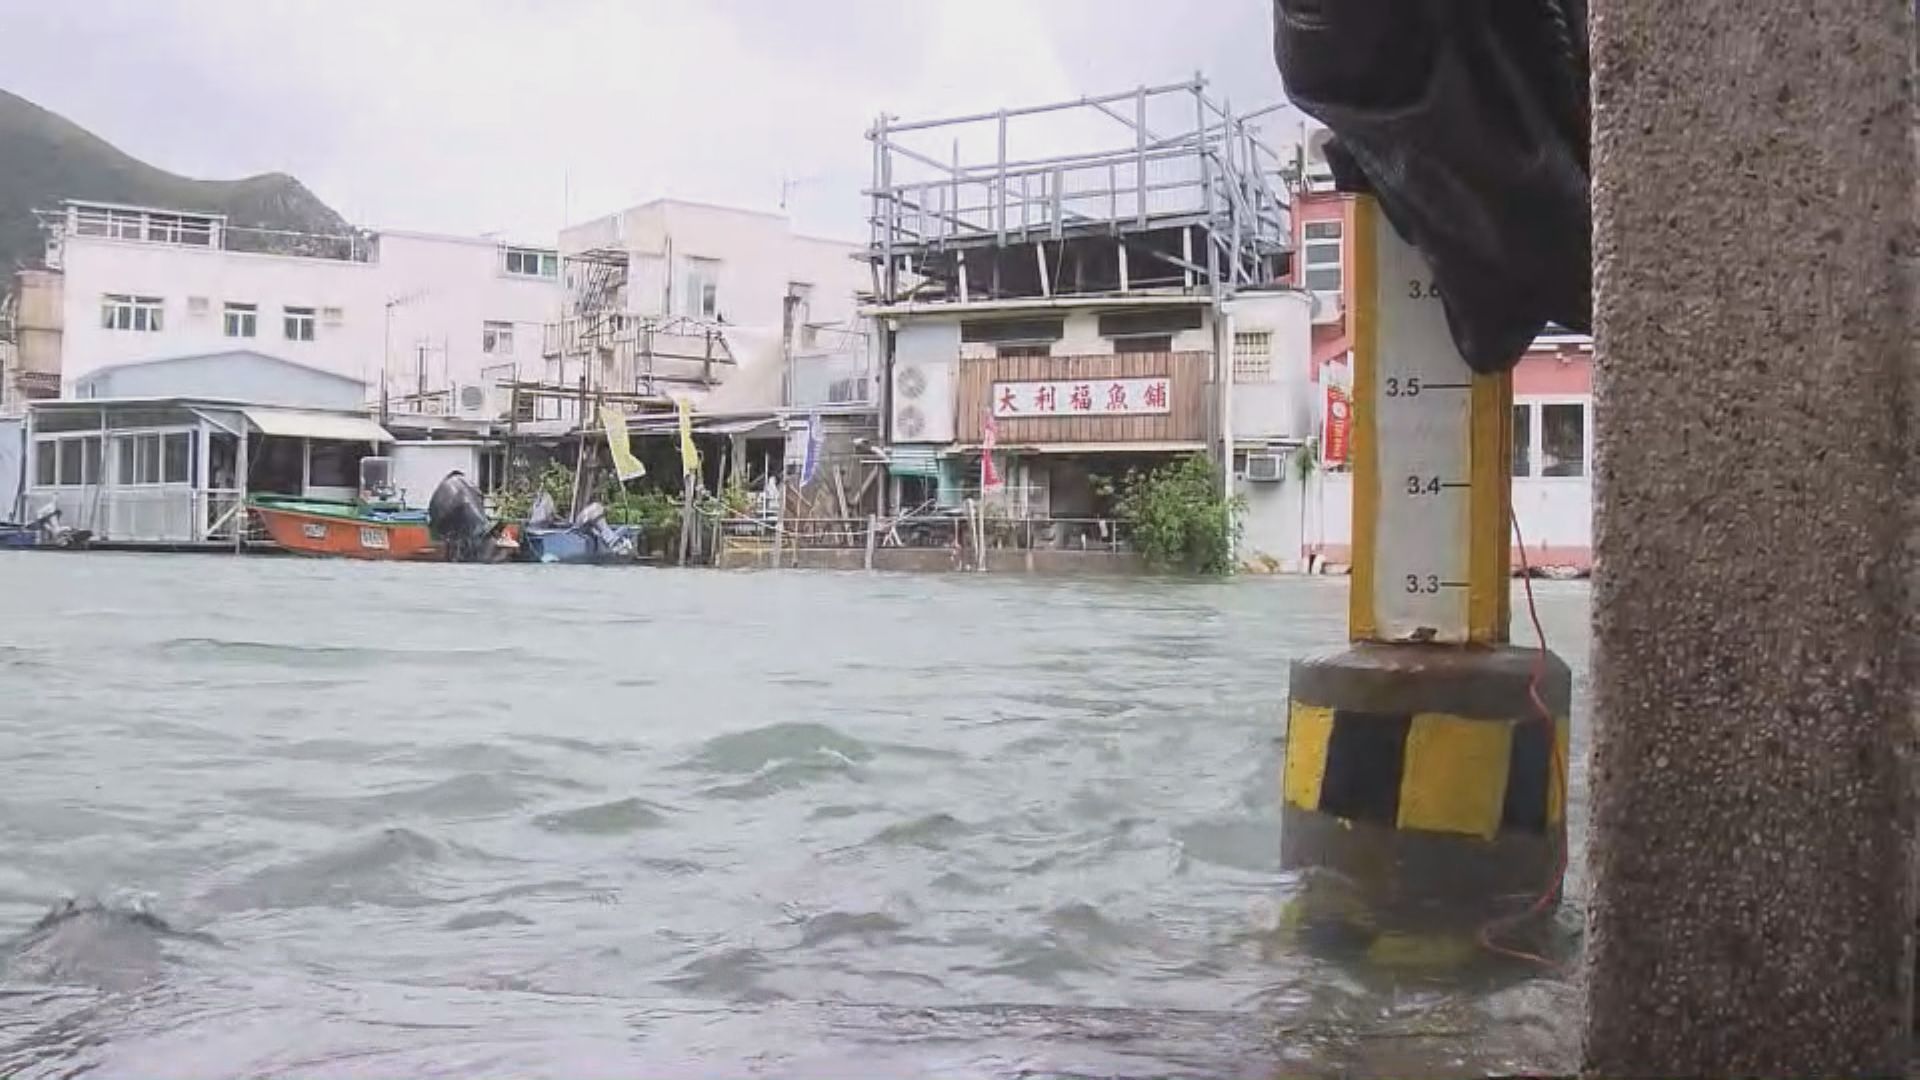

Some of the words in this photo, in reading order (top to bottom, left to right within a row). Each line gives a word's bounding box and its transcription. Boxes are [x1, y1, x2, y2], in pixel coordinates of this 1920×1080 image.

[1386, 378, 1420, 397] 3.5
[1407, 476, 1440, 494] 3.4
[1406, 575, 1438, 593] 3.3
